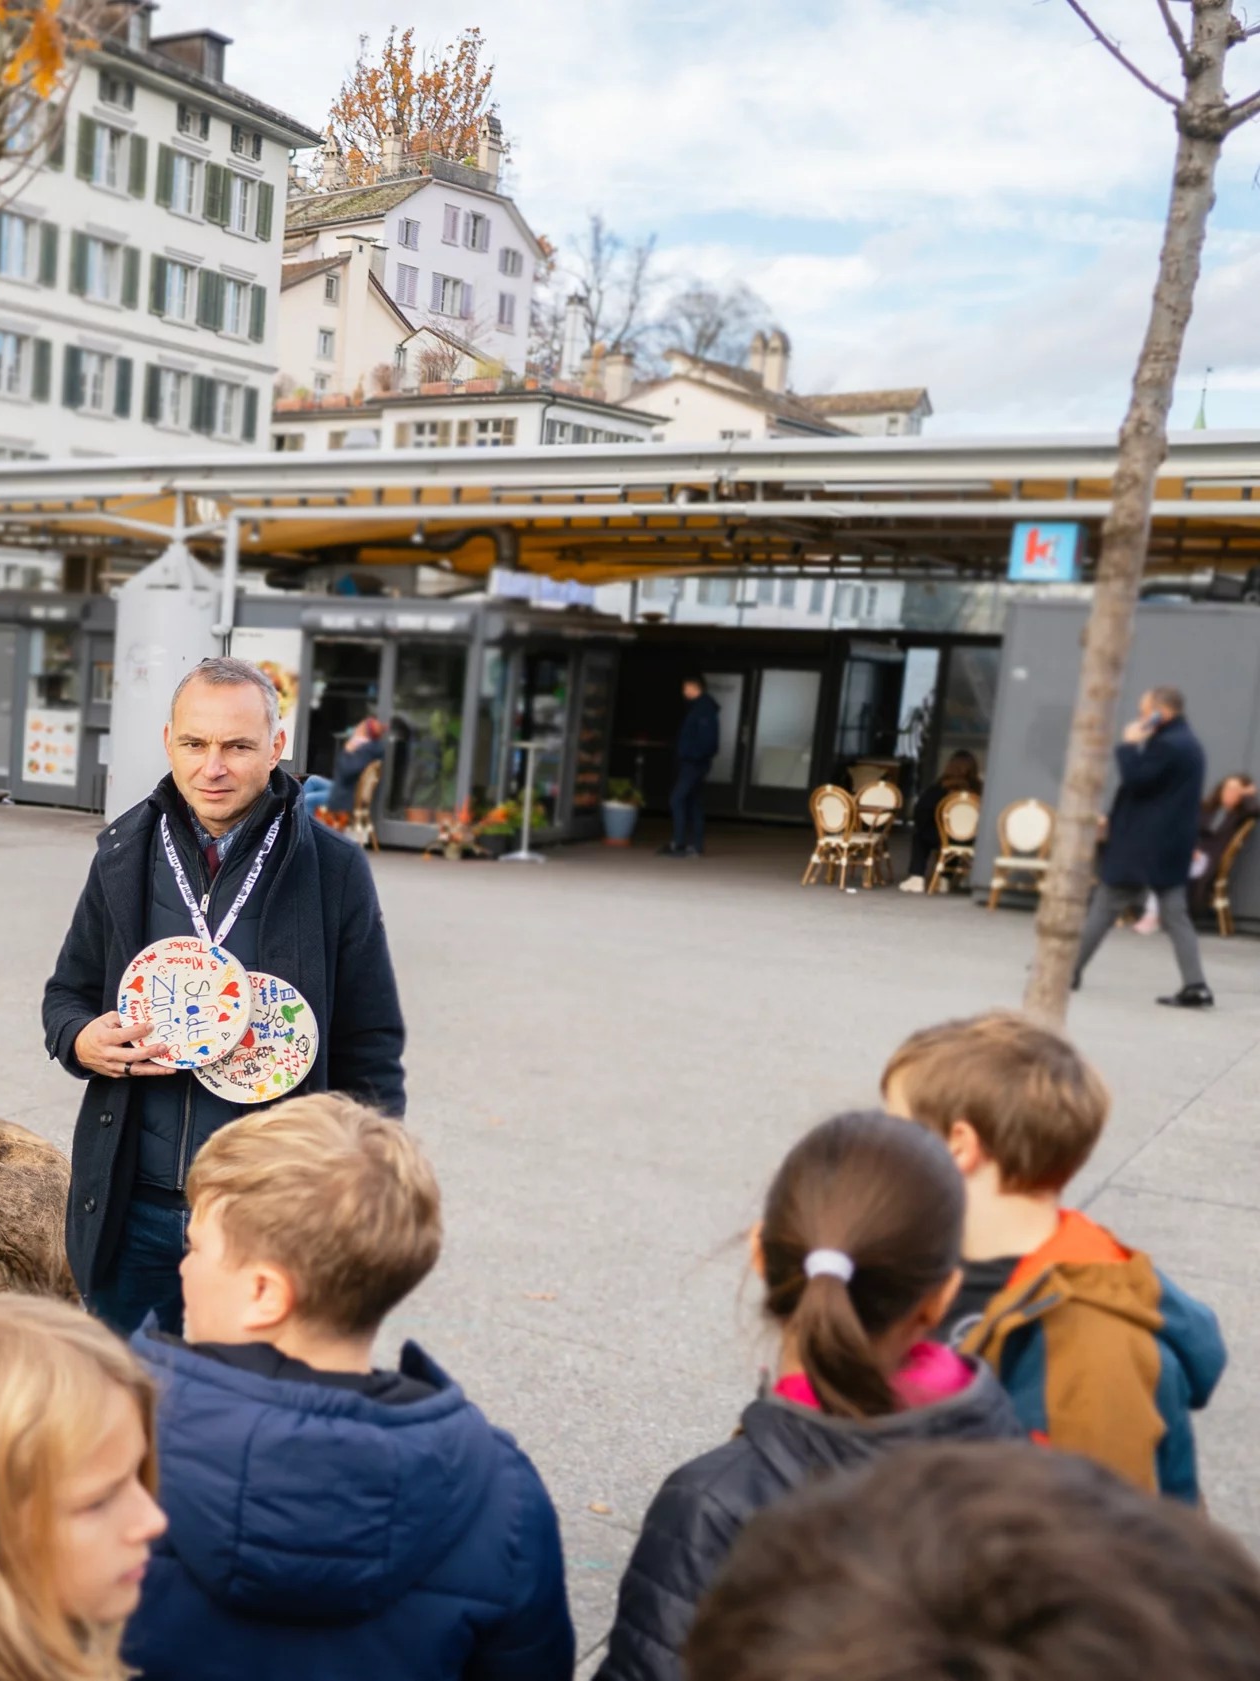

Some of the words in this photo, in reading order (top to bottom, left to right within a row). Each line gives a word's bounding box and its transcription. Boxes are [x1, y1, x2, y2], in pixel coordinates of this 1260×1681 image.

[165, 956, 204, 970] Klasse
[151, 974, 178, 1044] Zürich
[184, 980, 210, 1042] Stadt
